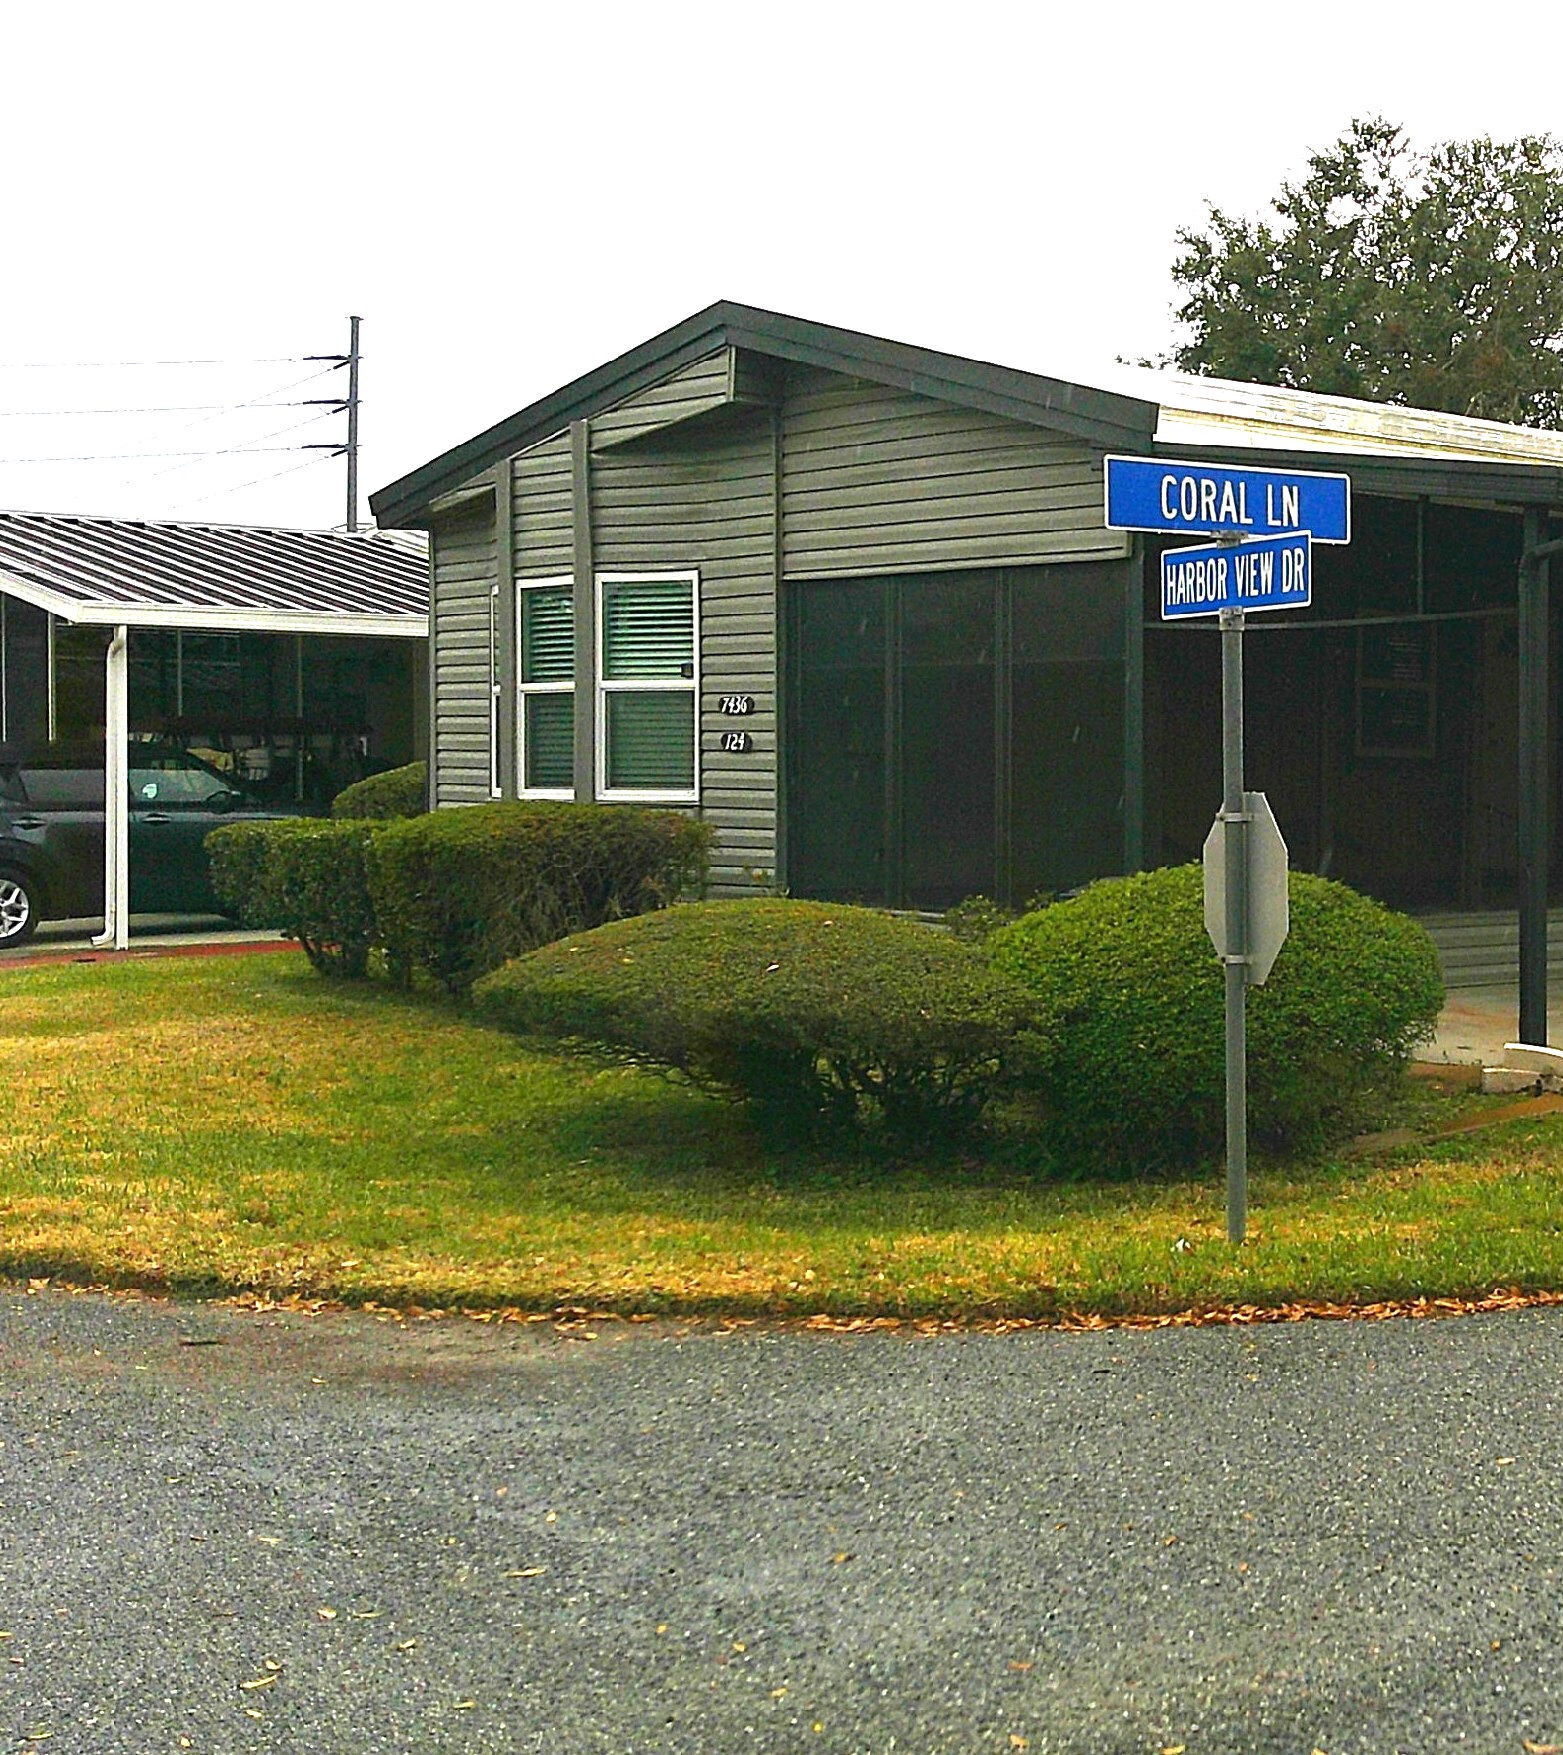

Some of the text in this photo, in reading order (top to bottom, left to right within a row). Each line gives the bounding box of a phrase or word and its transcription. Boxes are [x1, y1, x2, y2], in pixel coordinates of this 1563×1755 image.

[1161, 475, 1299, 527] CORAL LN
[1166, 547, 1305, 605] HARBOR VIEW DR
[721, 696, 748, 713] 7436
[725, 732, 745, 750] 124
